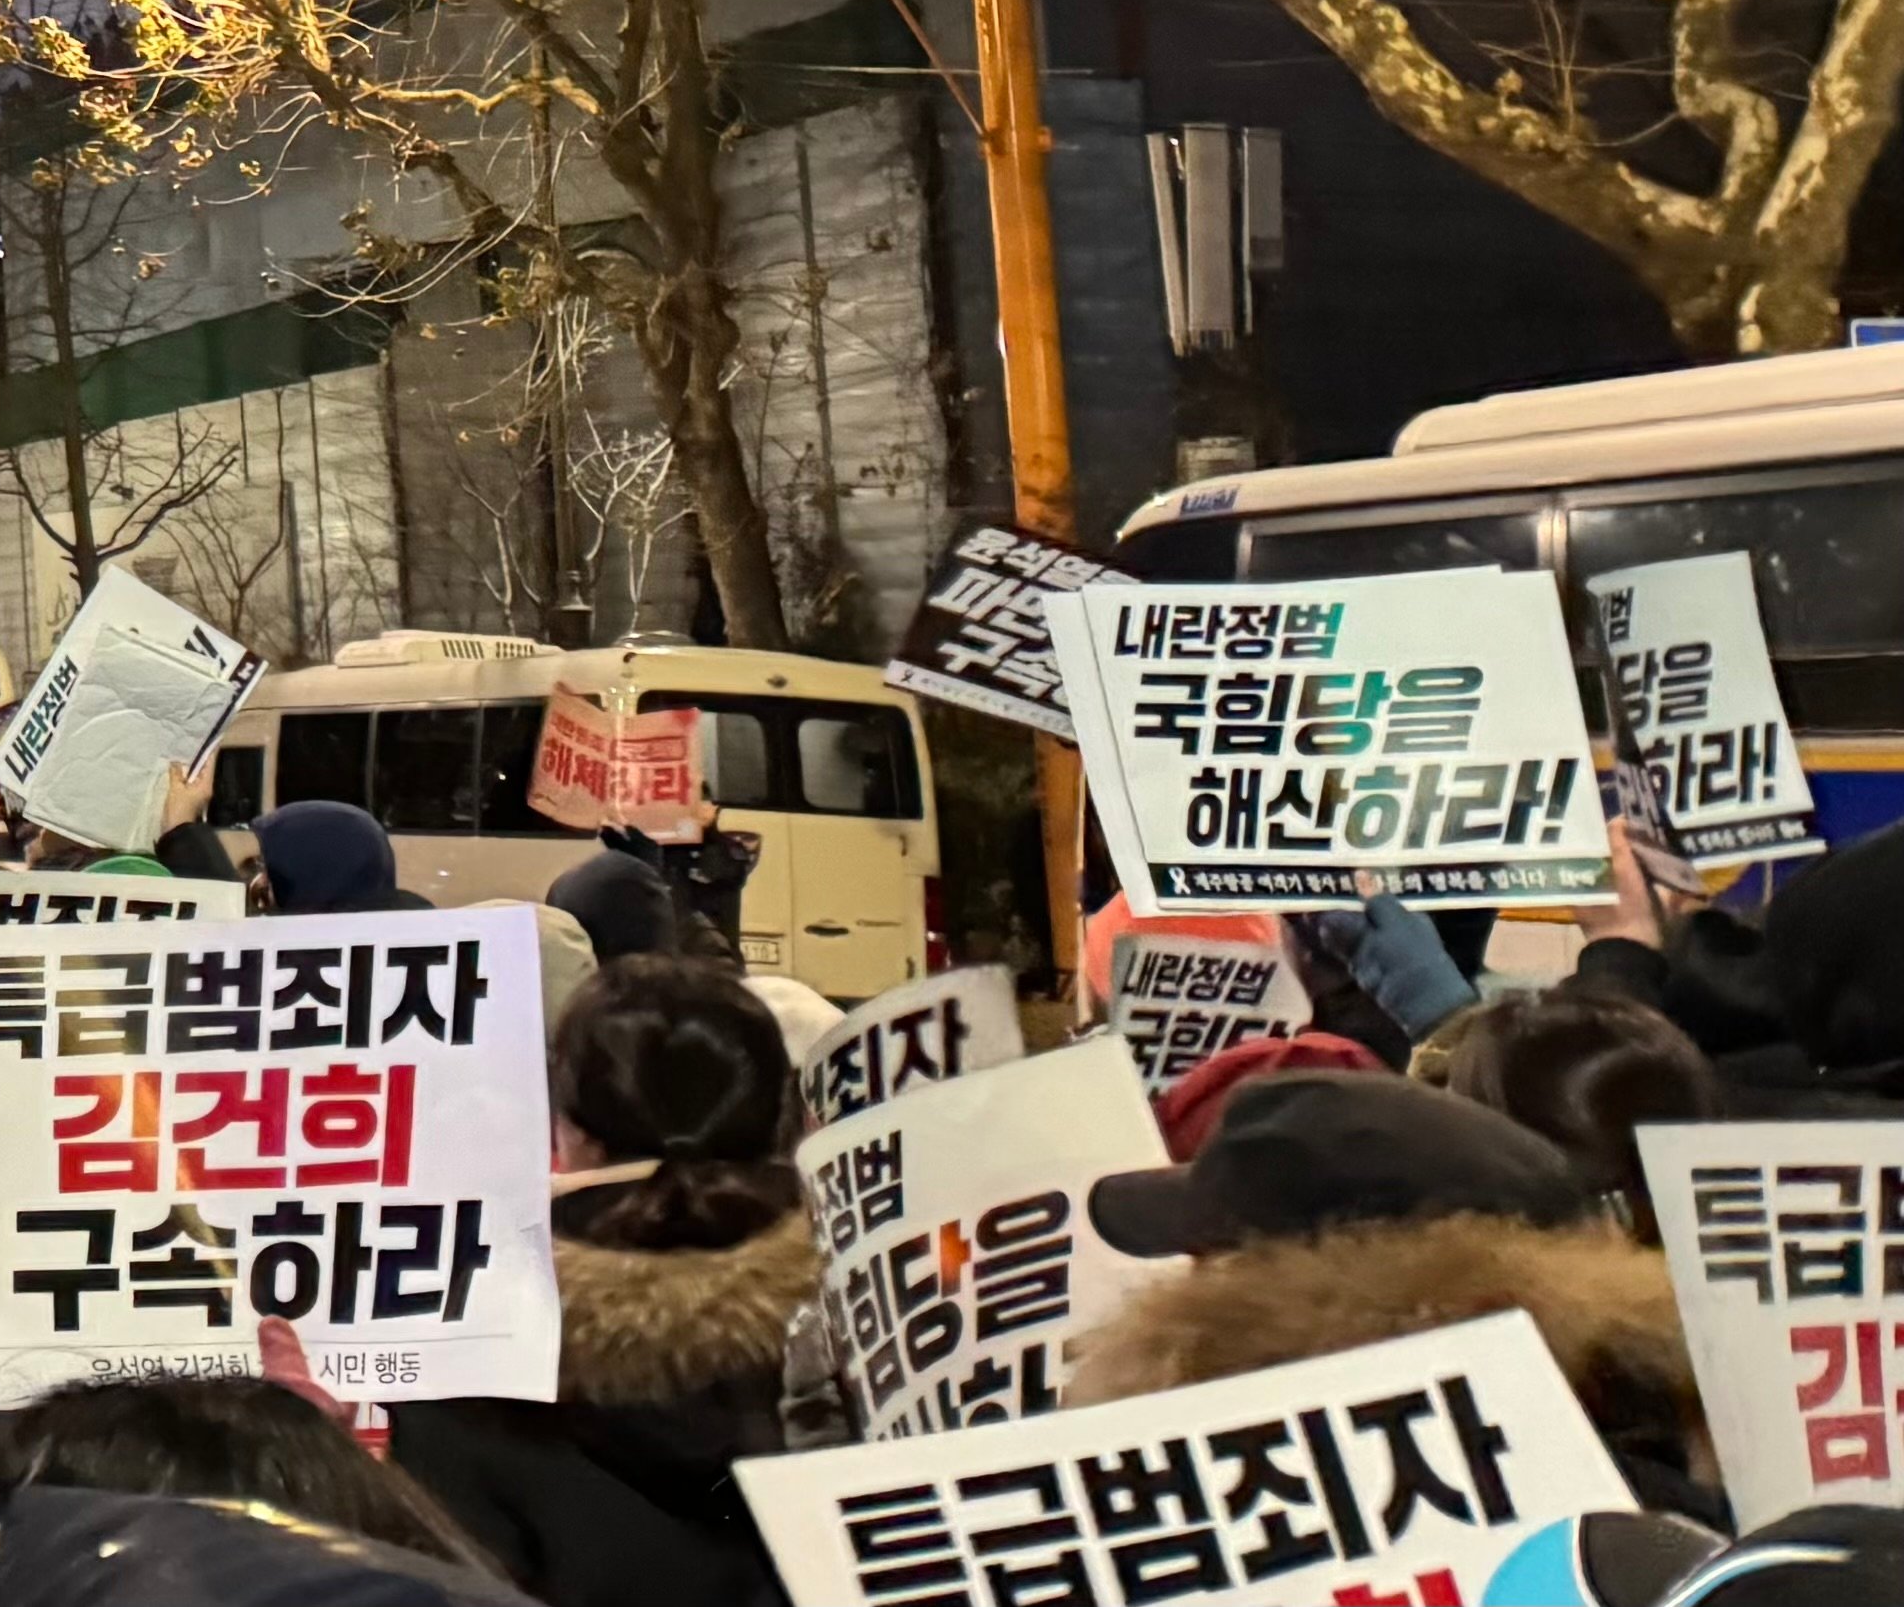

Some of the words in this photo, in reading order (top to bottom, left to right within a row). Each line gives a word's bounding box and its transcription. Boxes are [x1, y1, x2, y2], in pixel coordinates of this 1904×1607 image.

[1113, 601, 1345, 660] 내란정범
[1133, 664, 1485, 758] 국힘당을
[1186, 758, 1577, 853] 해산하라!
[1122, 951, 1278, 1006] 내란정범
[53, 1063, 417, 1196] 김건희
[13, 1197, 491, 1332] 구속하라
[320, 1352, 367, 1385] 시민
[374, 1352, 422, 1386] 행동
[837, 1375, 1518, 1607] 특급범죄자
